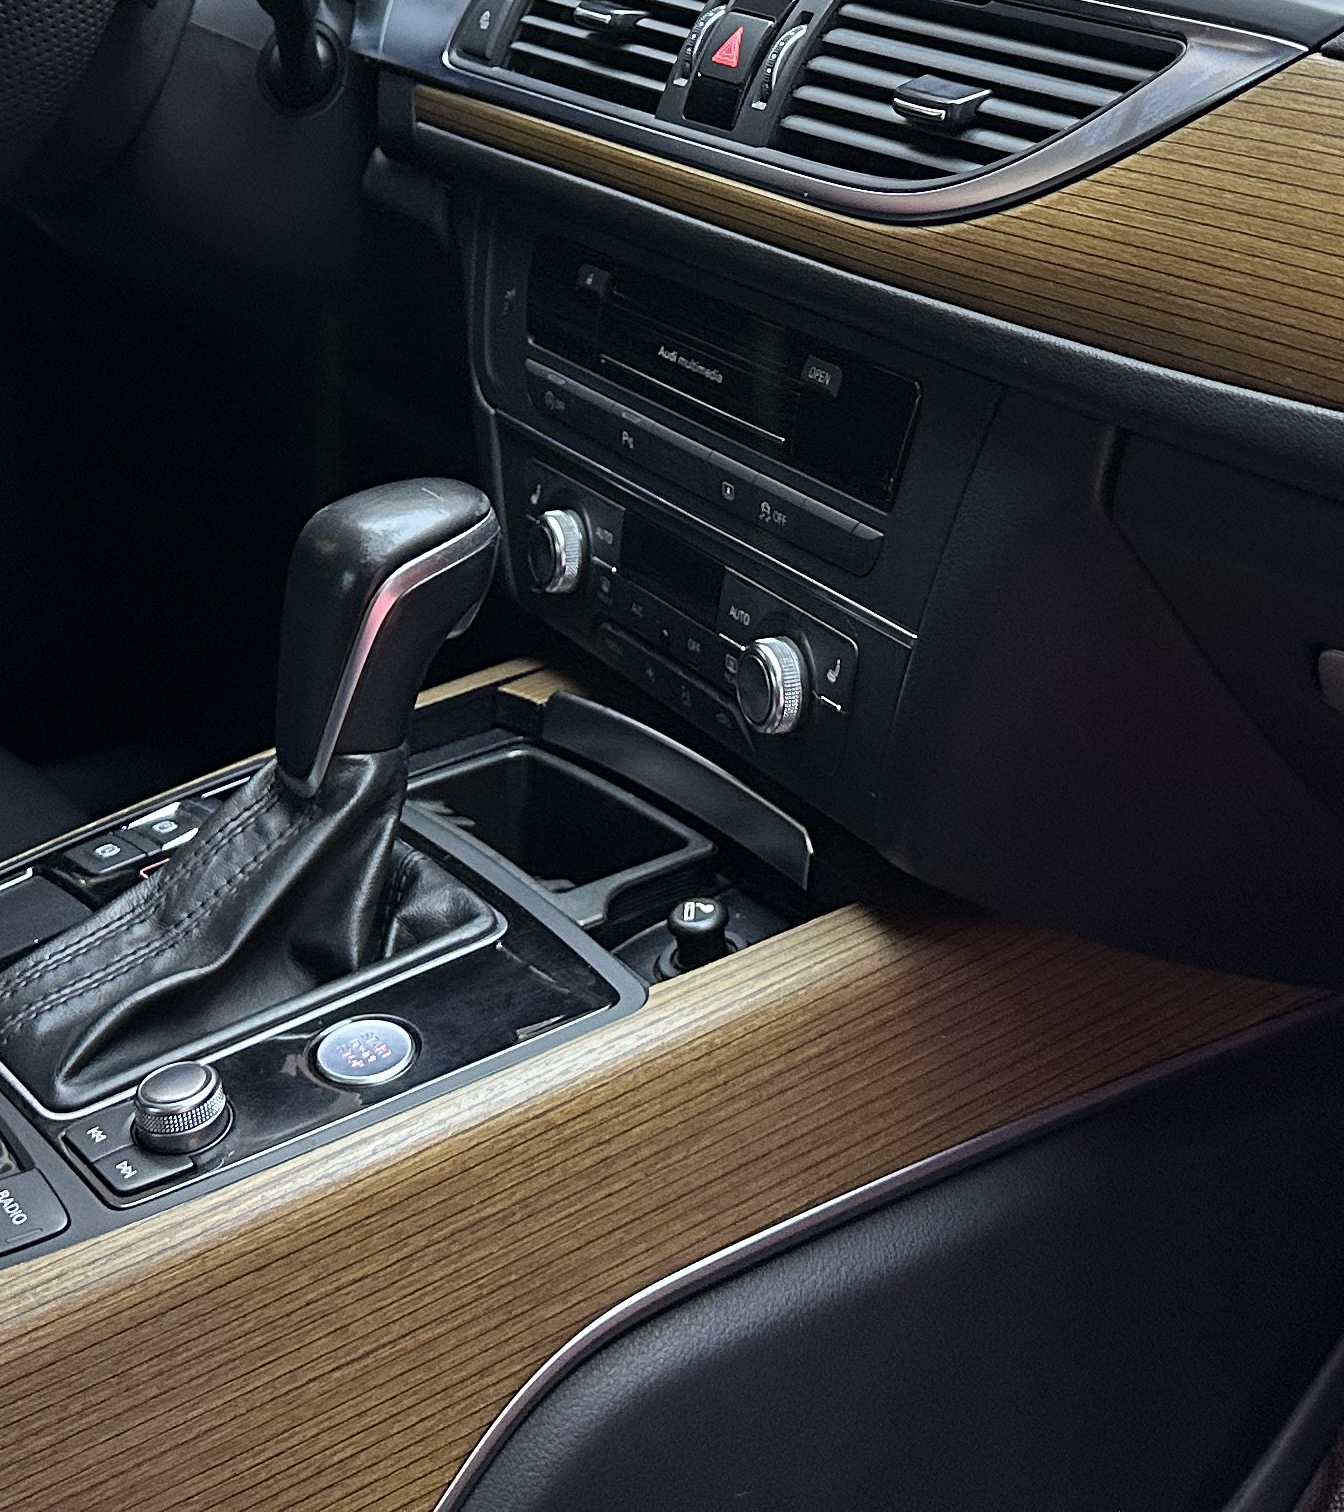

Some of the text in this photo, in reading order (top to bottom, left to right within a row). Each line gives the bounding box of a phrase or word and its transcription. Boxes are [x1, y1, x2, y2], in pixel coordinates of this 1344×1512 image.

[657, 345, 724, 384] Audi multimedia
[808, 365, 833, 386] OPEN
[771, 509, 789, 527] OFF
[728, 605, 751, 626] AUTO
[687, 637, 702, 654] OFF
